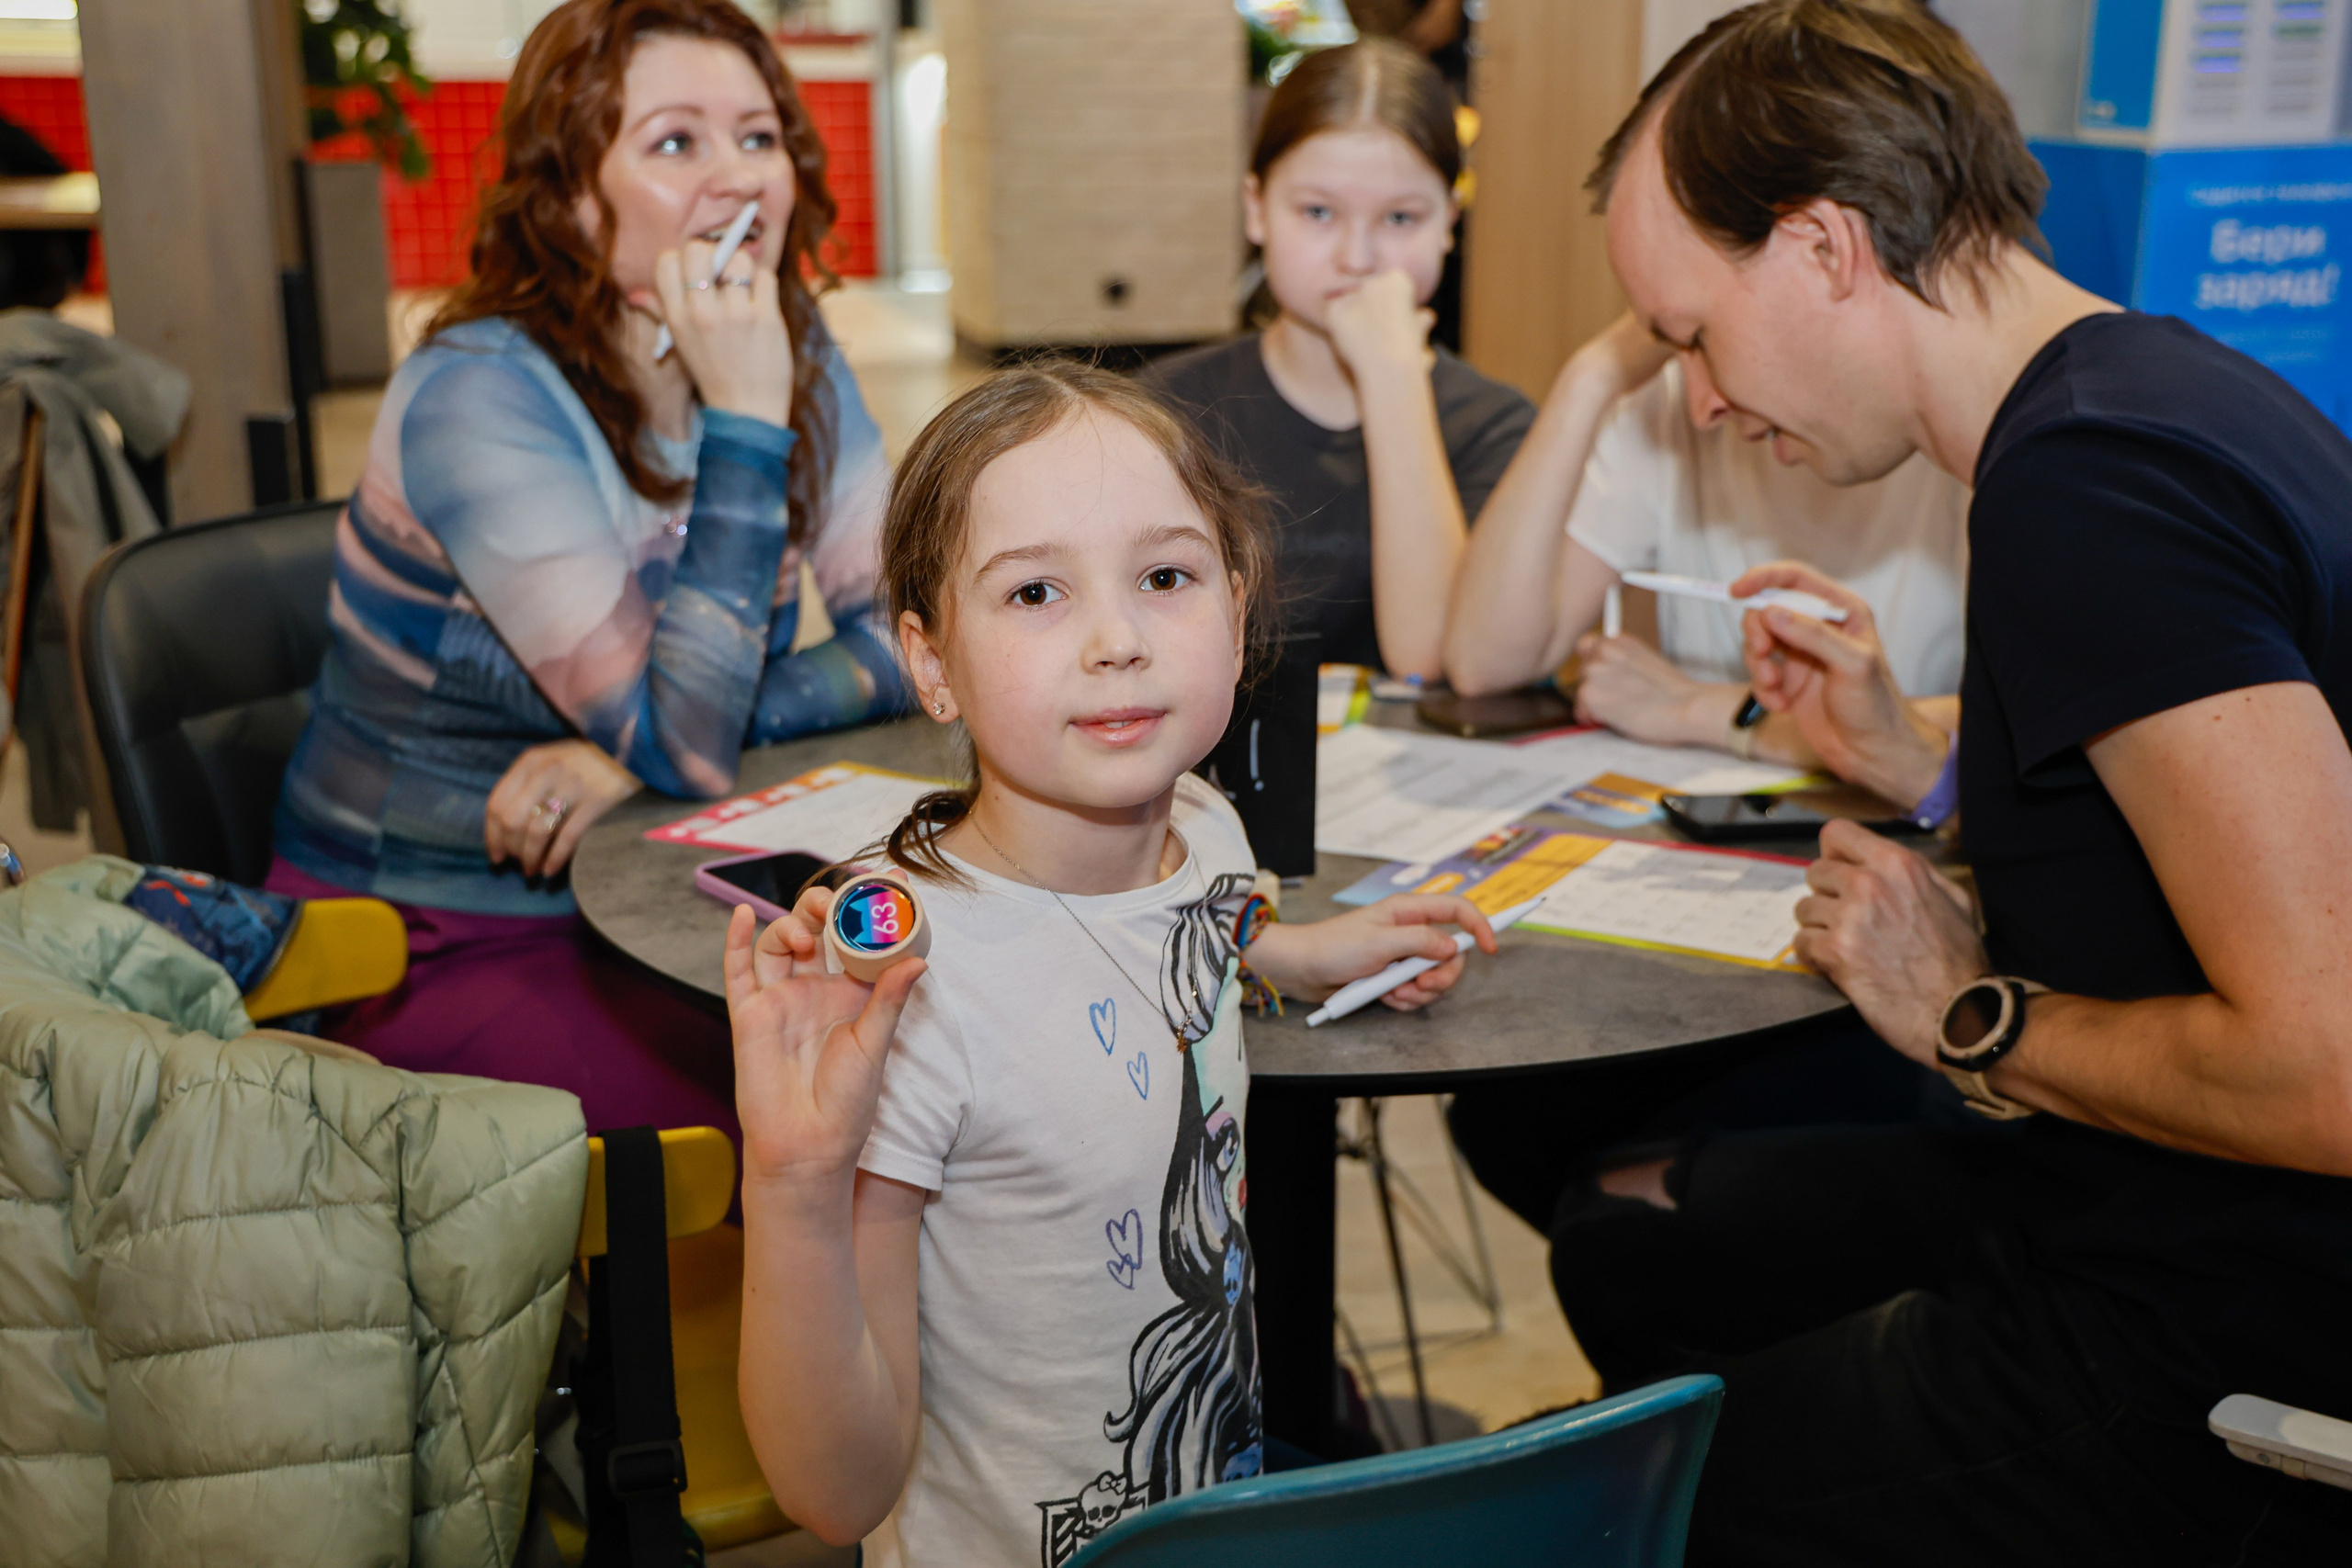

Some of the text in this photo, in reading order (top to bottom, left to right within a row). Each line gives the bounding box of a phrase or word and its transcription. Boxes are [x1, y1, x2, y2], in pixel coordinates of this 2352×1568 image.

[2211, 219, 2327, 264] Бери
[2195, 263, 2340, 310] заряд!
[871, 902, 899, 934] 63
